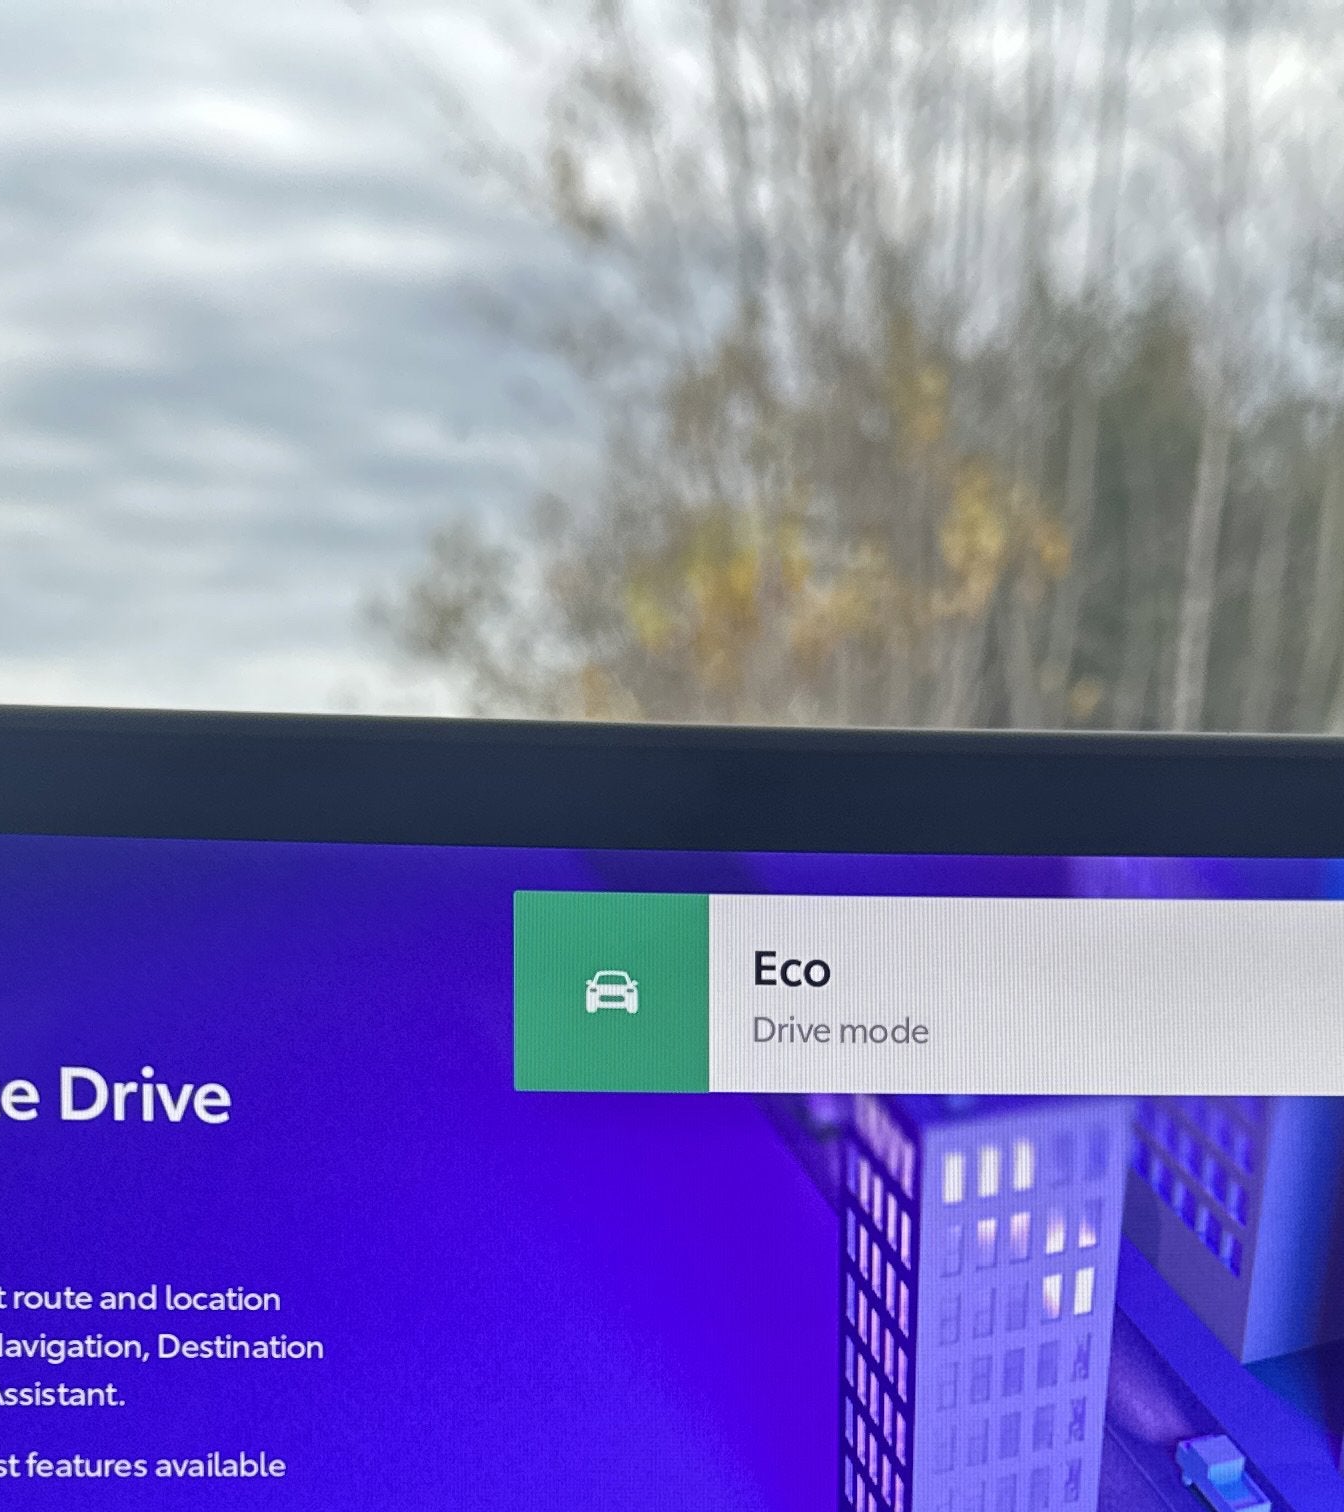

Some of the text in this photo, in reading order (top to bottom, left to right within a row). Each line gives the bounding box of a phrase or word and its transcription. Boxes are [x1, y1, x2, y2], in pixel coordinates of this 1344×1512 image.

[754, 950, 832, 988] Eco
[753, 1015, 930, 1045] Drive mode
[60, 1065, 231, 1124] Drive
[13, 1285, 93, 1311] route
[99, 1283, 157, 1311] and
[165, 1283, 281, 1312] location
[158, 1333, 325, 1360] Destination
[25, 1451, 149, 1479] features
[155, 1451, 287, 1479] available
